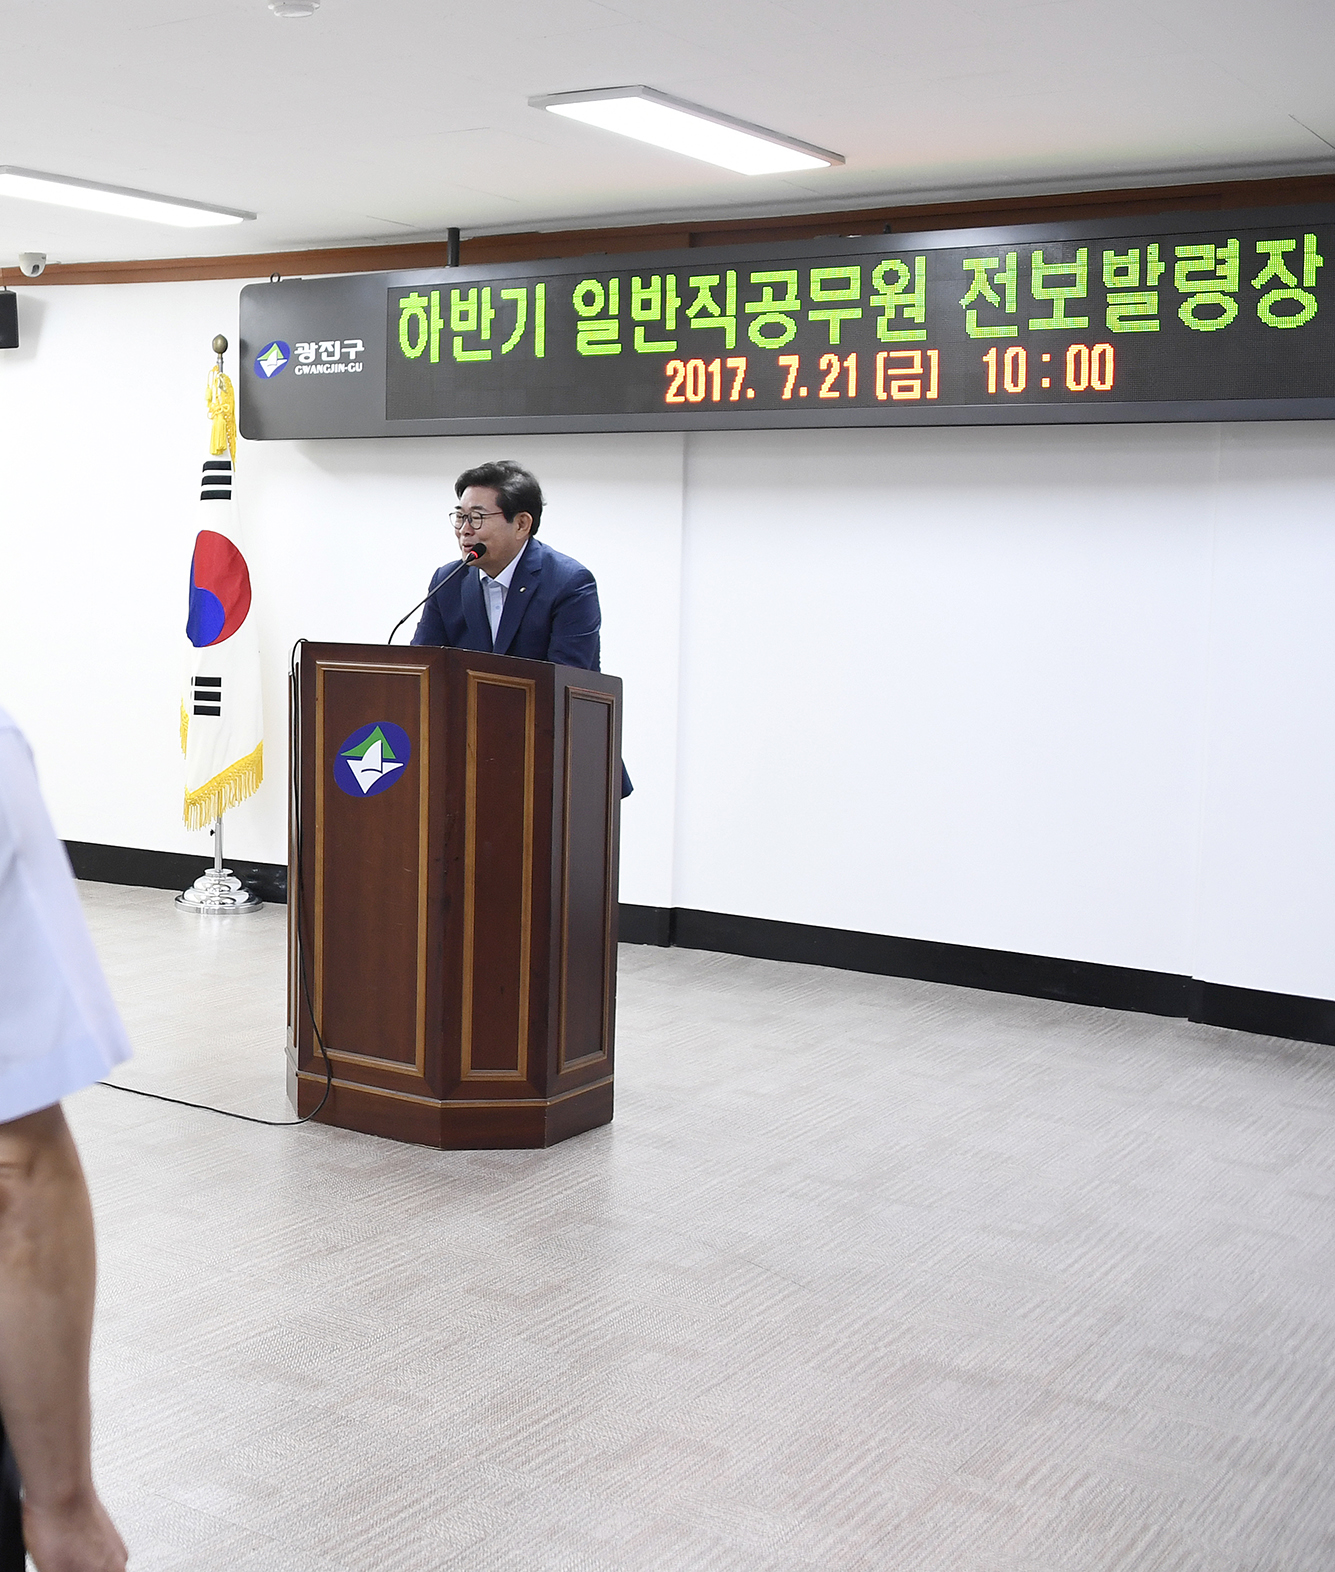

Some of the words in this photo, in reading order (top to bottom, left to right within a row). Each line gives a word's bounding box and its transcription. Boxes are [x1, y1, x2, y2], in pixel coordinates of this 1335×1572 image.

[396, 281, 547, 363] 하반기
[571, 255, 928, 357] 일반직공무원
[959, 233, 1325, 340] 전보발령장
[293, 338, 365, 364] 광진구
[294, 361, 364, 376] GWANGJIN-GU
